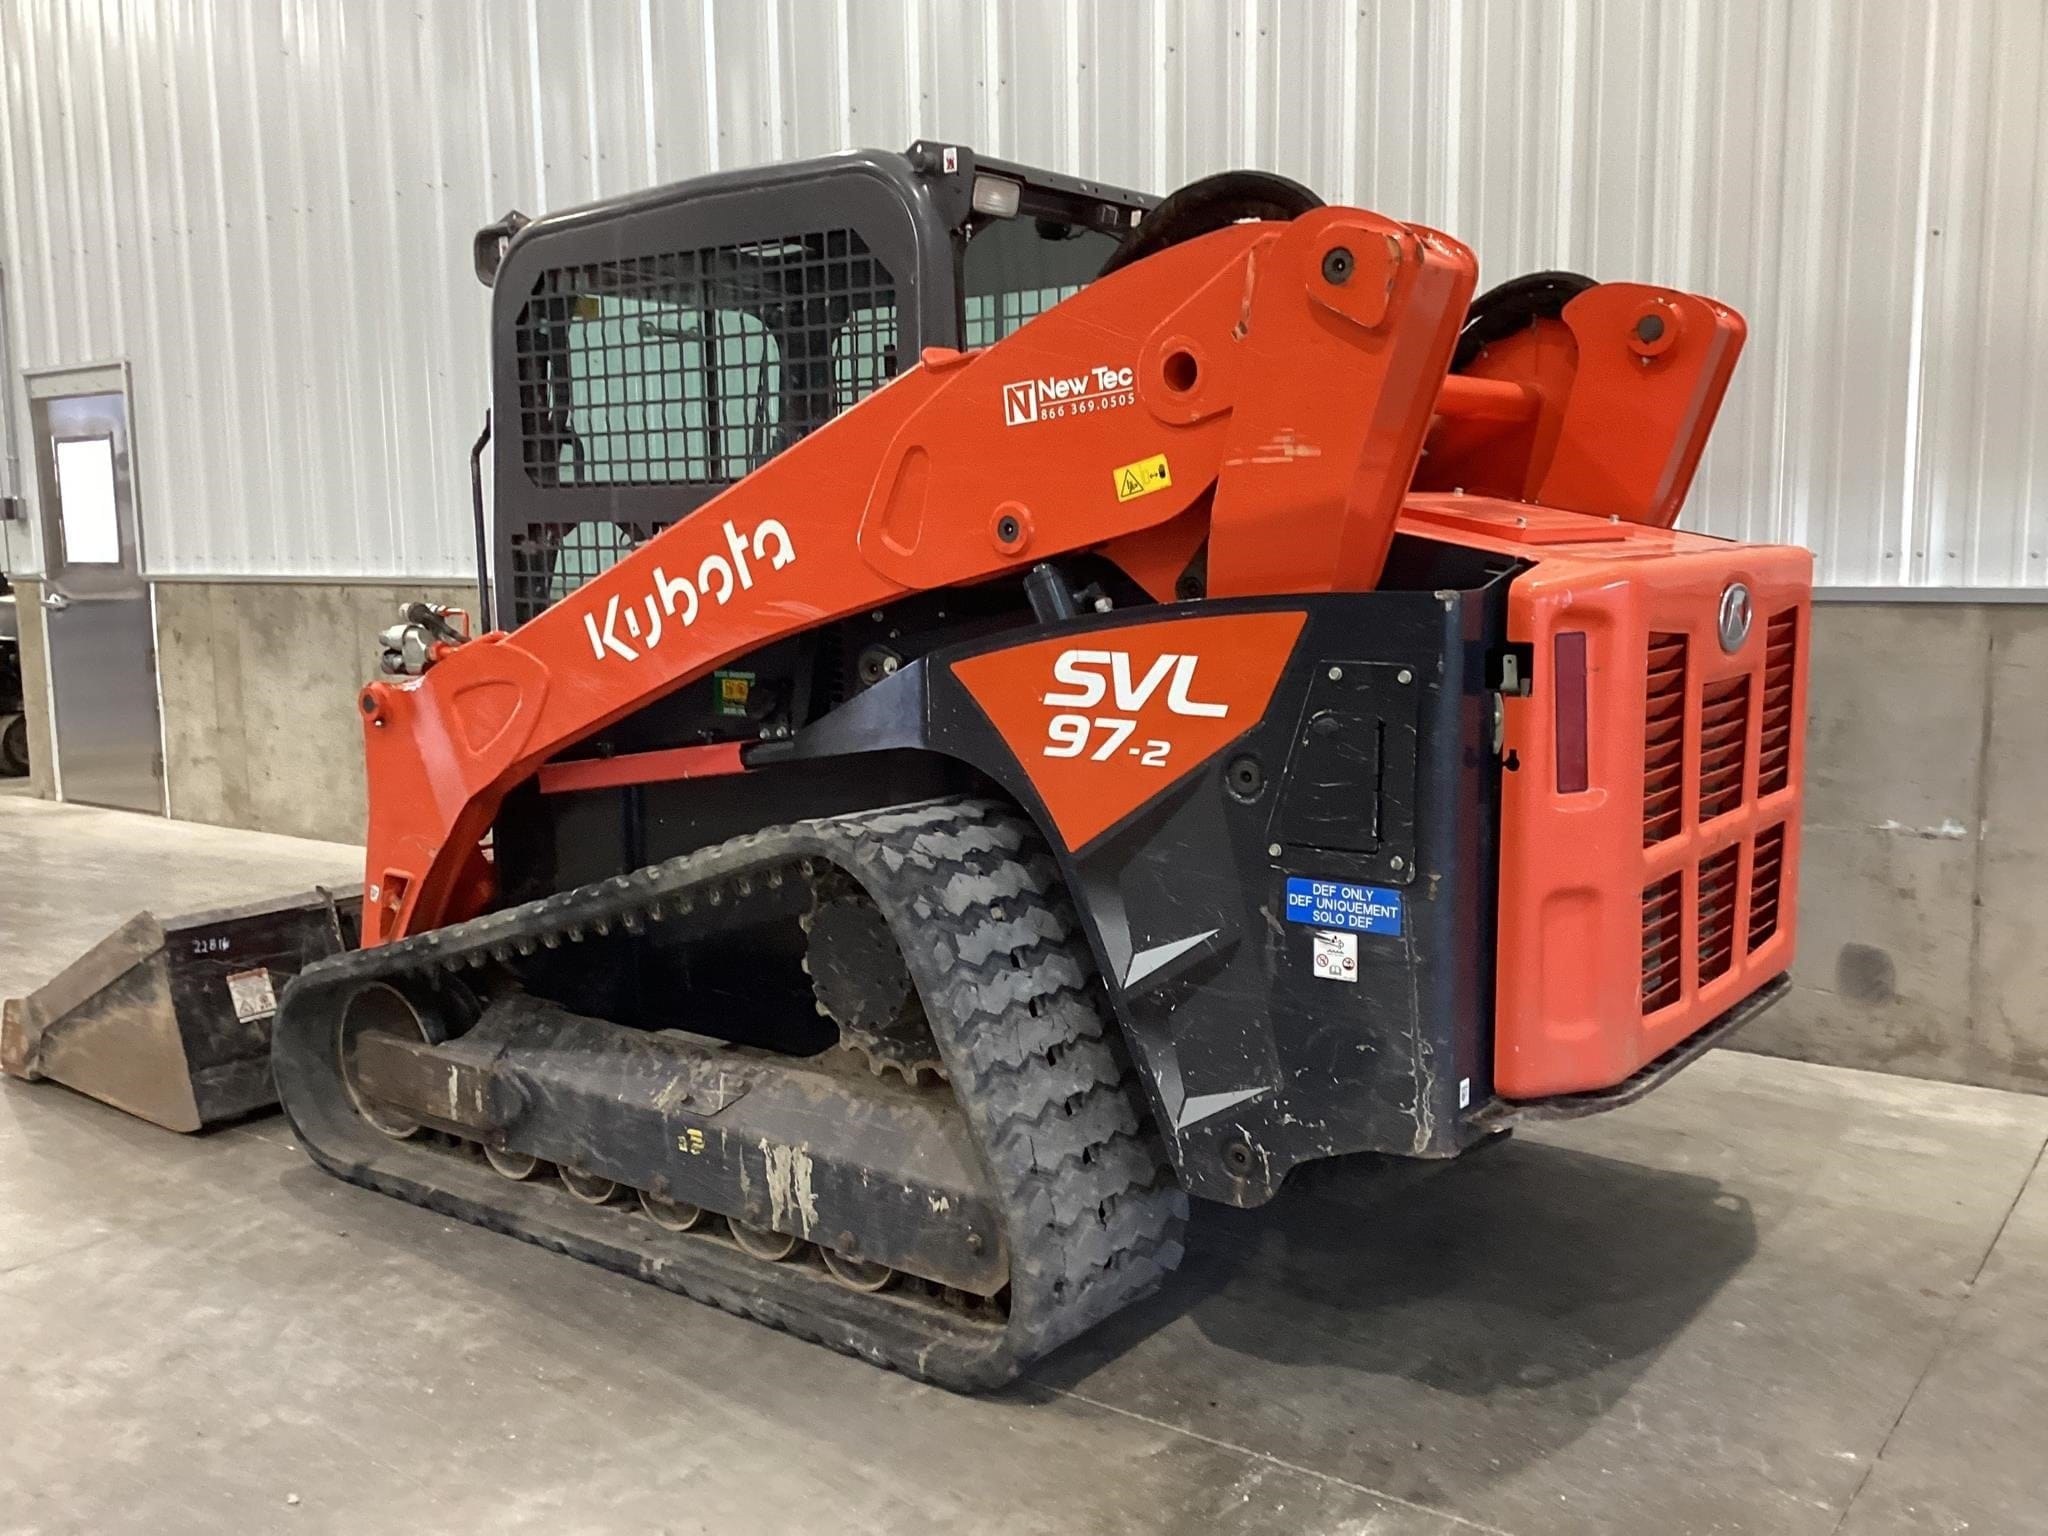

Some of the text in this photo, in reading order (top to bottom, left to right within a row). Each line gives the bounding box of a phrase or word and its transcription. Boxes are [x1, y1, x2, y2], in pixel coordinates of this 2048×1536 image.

[1037, 375, 1089, 402] New
[1091, 366, 1134, 391] Tec
[1041, 393, 1135, 421] 866 369.0505
[583, 519, 796, 662] Kubota
[1043, 649, 1229, 718] SVL
[1043, 714, 1172, 767] 97-2
[1289, 893, 1398, 919] DEF UNIQUEMENT
[1312, 883, 1374, 902] DEF ONLY
[1312, 911, 1373, 929] SOLO DEF
